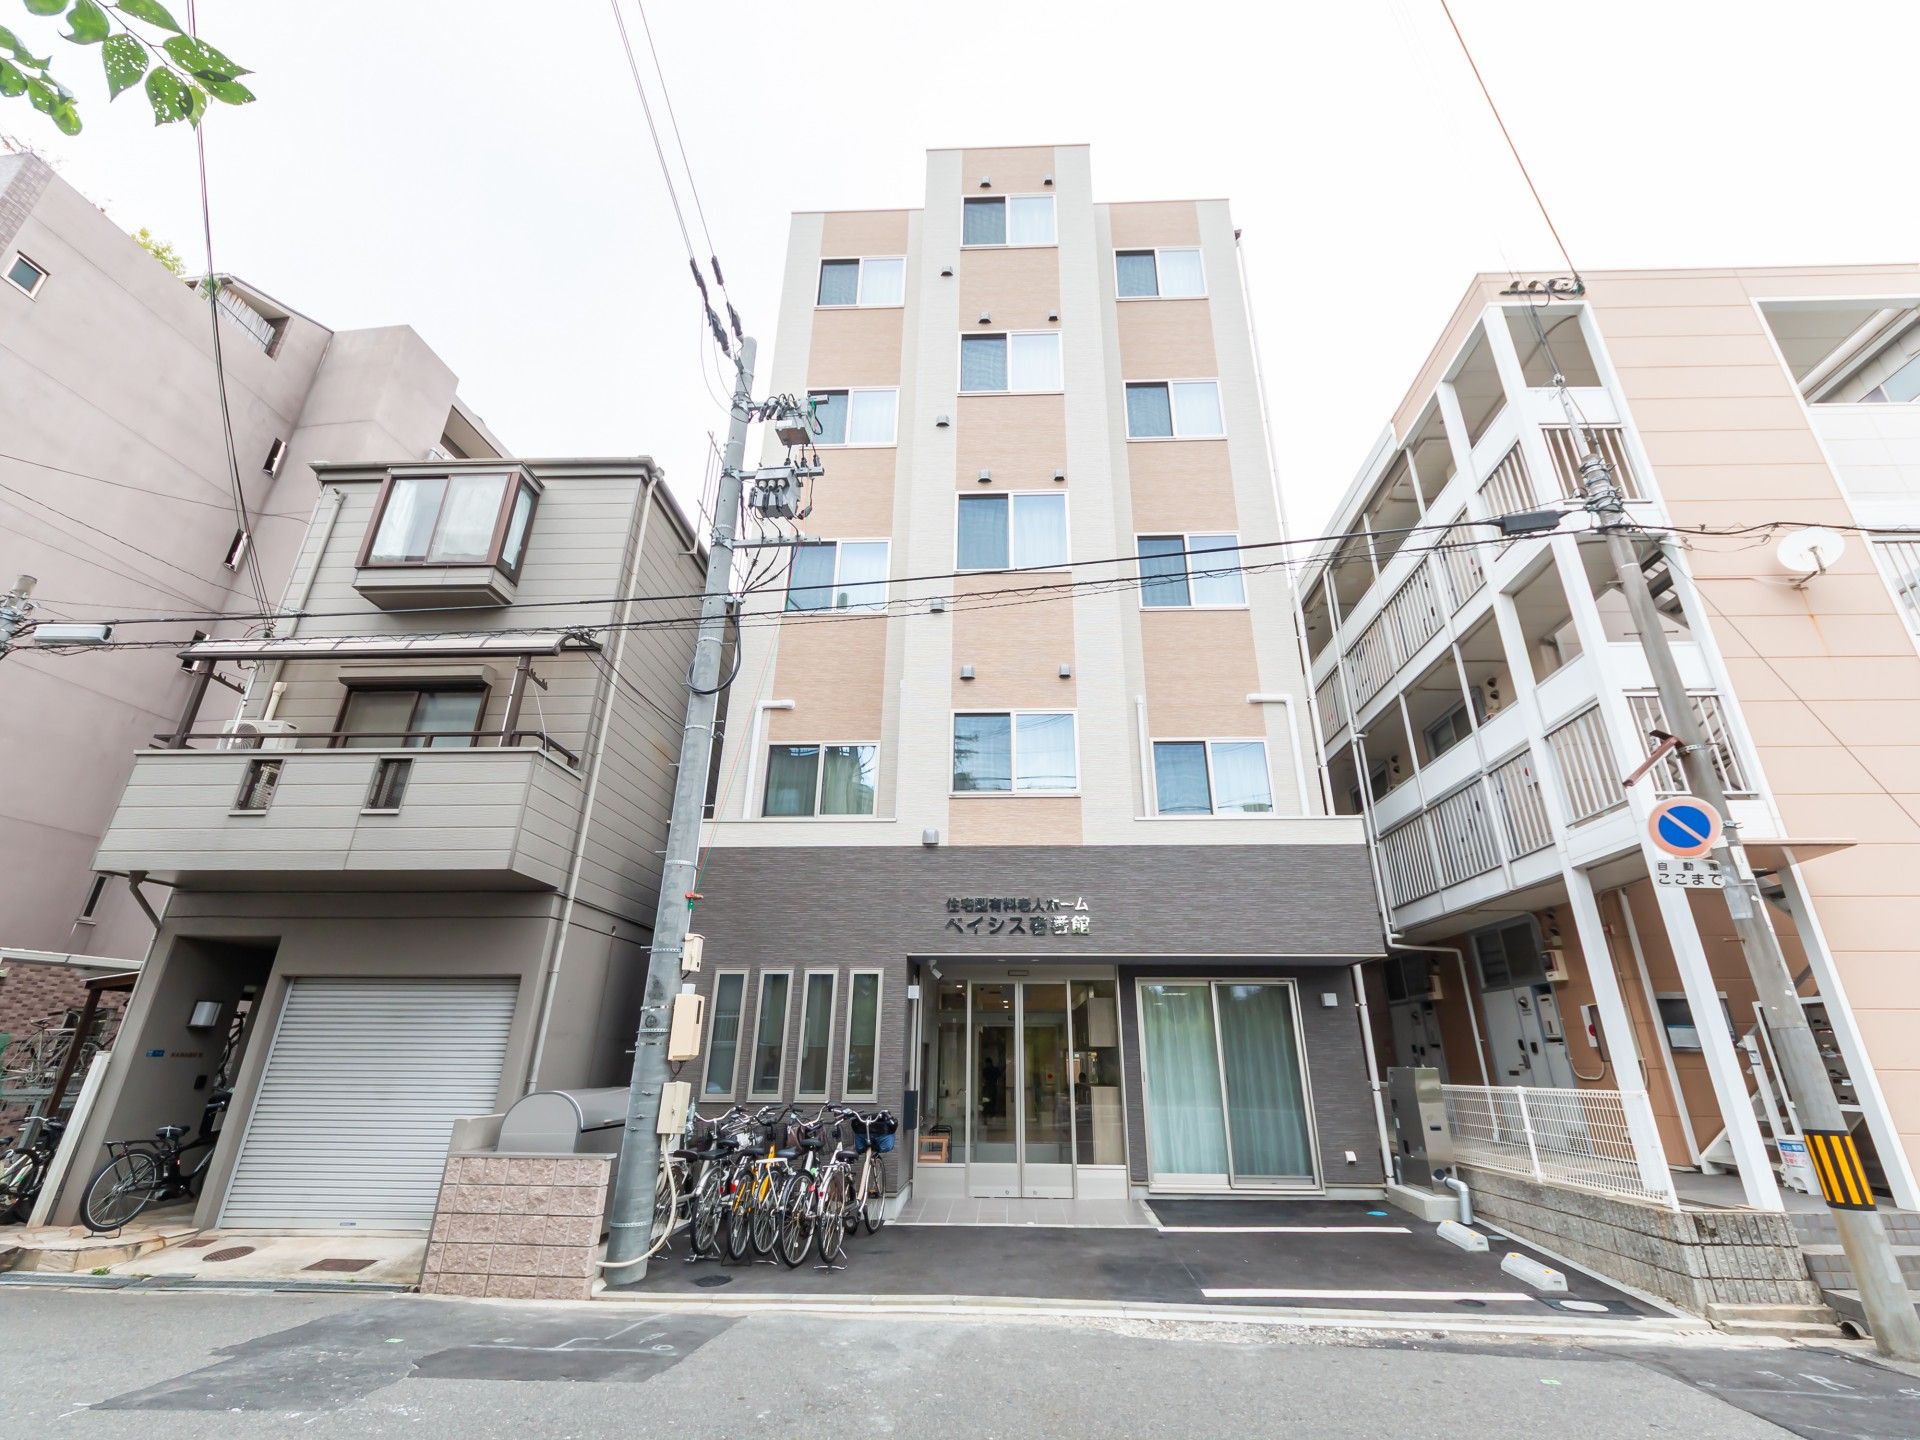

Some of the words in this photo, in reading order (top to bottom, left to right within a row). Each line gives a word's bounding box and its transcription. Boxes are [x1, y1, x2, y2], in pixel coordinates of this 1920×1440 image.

[945, 896, 1089, 913] 住宅型有料老人ホーム
